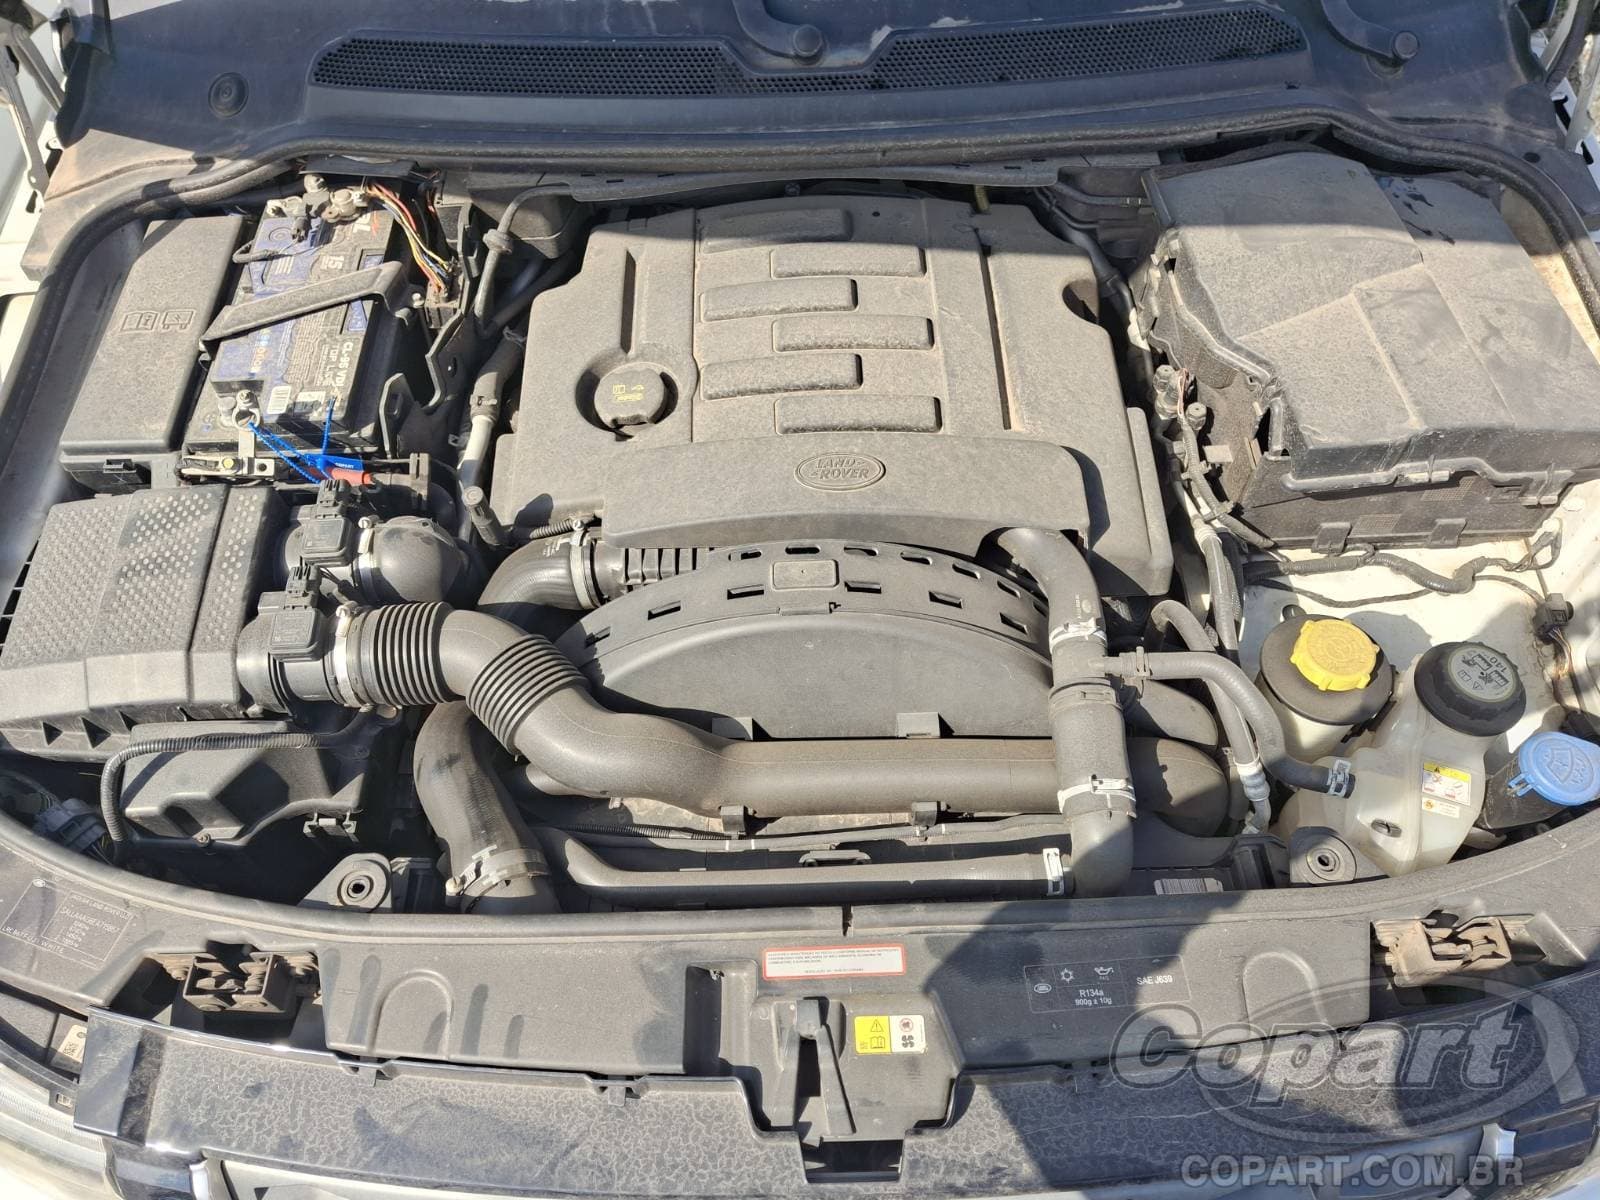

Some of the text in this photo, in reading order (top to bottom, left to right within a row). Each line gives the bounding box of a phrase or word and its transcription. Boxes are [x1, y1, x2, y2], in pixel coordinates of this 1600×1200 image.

[340, 342, 354, 370] CL-95
[816, 457, 856, 468] LAND
[819, 468, 869, 480] ROVER
[1488, 656, 1507, 673] 140
[1136, 974, 1173, 985] SAE J639
[1078, 988, 1104, 998] R134a
